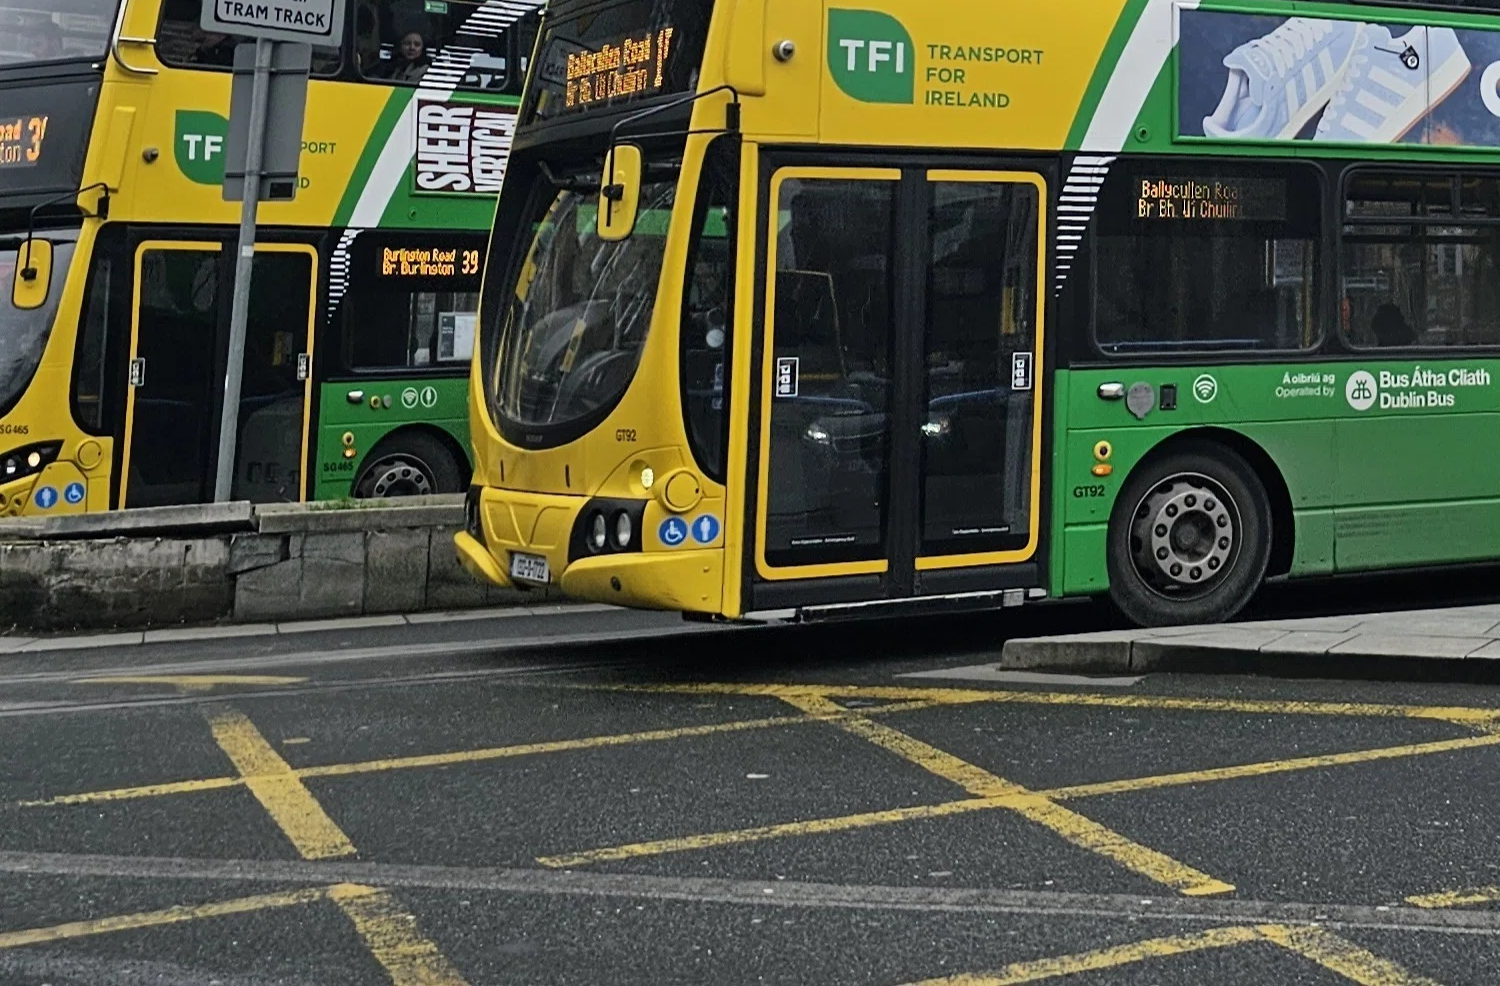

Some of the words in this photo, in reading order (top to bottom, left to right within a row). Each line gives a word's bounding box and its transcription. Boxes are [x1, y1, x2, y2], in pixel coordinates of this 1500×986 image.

[224, 1, 269, 20] TRAM
[274, 7, 325, 28] TRACK
[840, 39, 904, 73] TFI
[927, 44, 1044, 65] TRANSPORT
[926, 68, 966, 83] FOR
[925, 90, 1010, 108] IRELAND
[183, 134, 223, 161] TF
[417, 104, 473, 191] SHEER
[1142, 180, 1210, 199] Ballycullen
[1138, 199, 1154, 217] Br
[384, 247, 430, 262] Burlington
[433, 248, 456, 262] Road
[462, 250, 479, 274] 39
[401, 261, 454, 275] Burlington
[1323, 373, 1335, 385] ag
[1380, 371, 1409, 388] Bus
[1411, 366, 1446, 387] Átha
[1449, 369, 1490, 386] Cliath
[1275, 386, 1320, 398] Operated
[1323, 385, 1335, 398] by
[1380, 391, 1425, 408] Dublin
[1428, 392, 1455, 407] Bus
[616, 429, 637, 442] GT92
[1073, 485, 1105, 498] GT92
